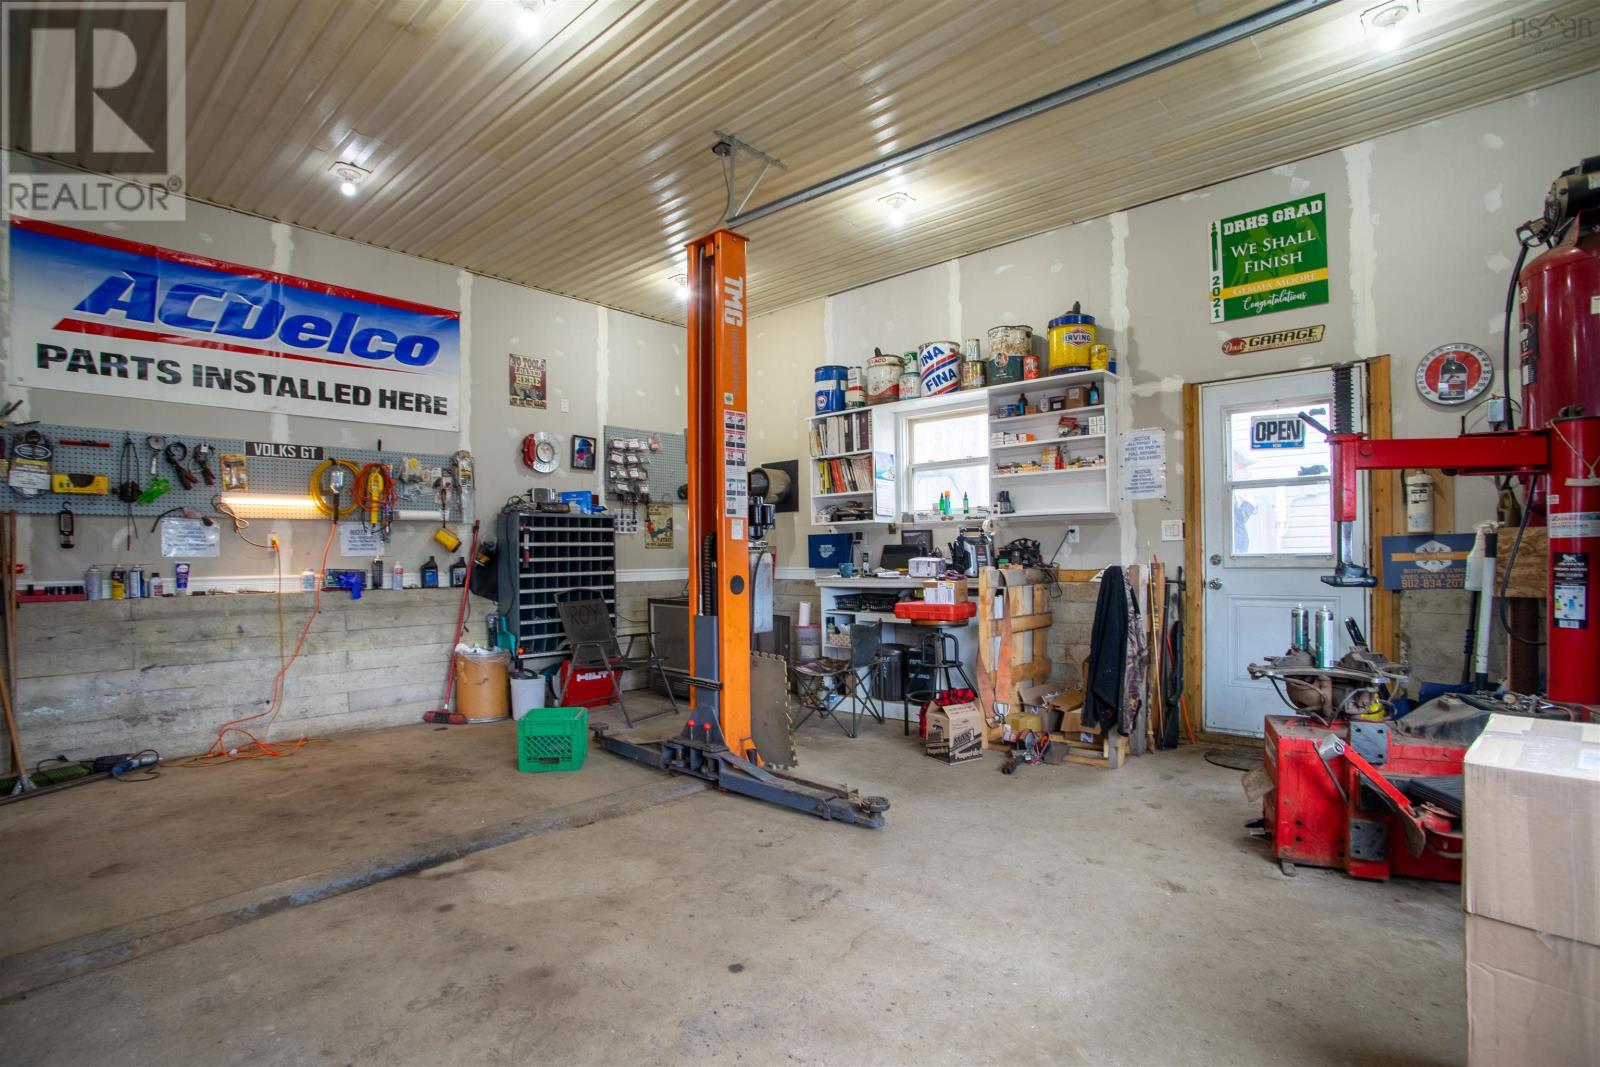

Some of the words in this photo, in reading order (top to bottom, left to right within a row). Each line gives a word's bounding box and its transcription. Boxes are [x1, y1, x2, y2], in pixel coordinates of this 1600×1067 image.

[1223, 213, 1269, 235] DRHS
[1272, 200, 1323, 224] GRAD
[1230, 242, 1257, 258] WE
[1263, 230, 1317, 252] SHALL
[1244, 251, 1303, 274] FINISH
[723, 276, 743, 328] TMG
[1243, 289, 1307, 313] Congratulations
[73, 269, 440, 367] ACDelco
[1064, 333, 1091, 343] IRVING
[1249, 327, 1319, 347] GARAGE
[921, 345, 945, 367] INA
[36, 342, 182, 385] PARTS
[192, 364, 372, 407] INSTALLED
[379, 388, 448, 416] HERE
[925, 368, 957, 392] FINA
[1255, 420, 1301, 441] OPEN
[253, 443, 296, 458] VOLKS
[300, 446, 317, 459] GT
